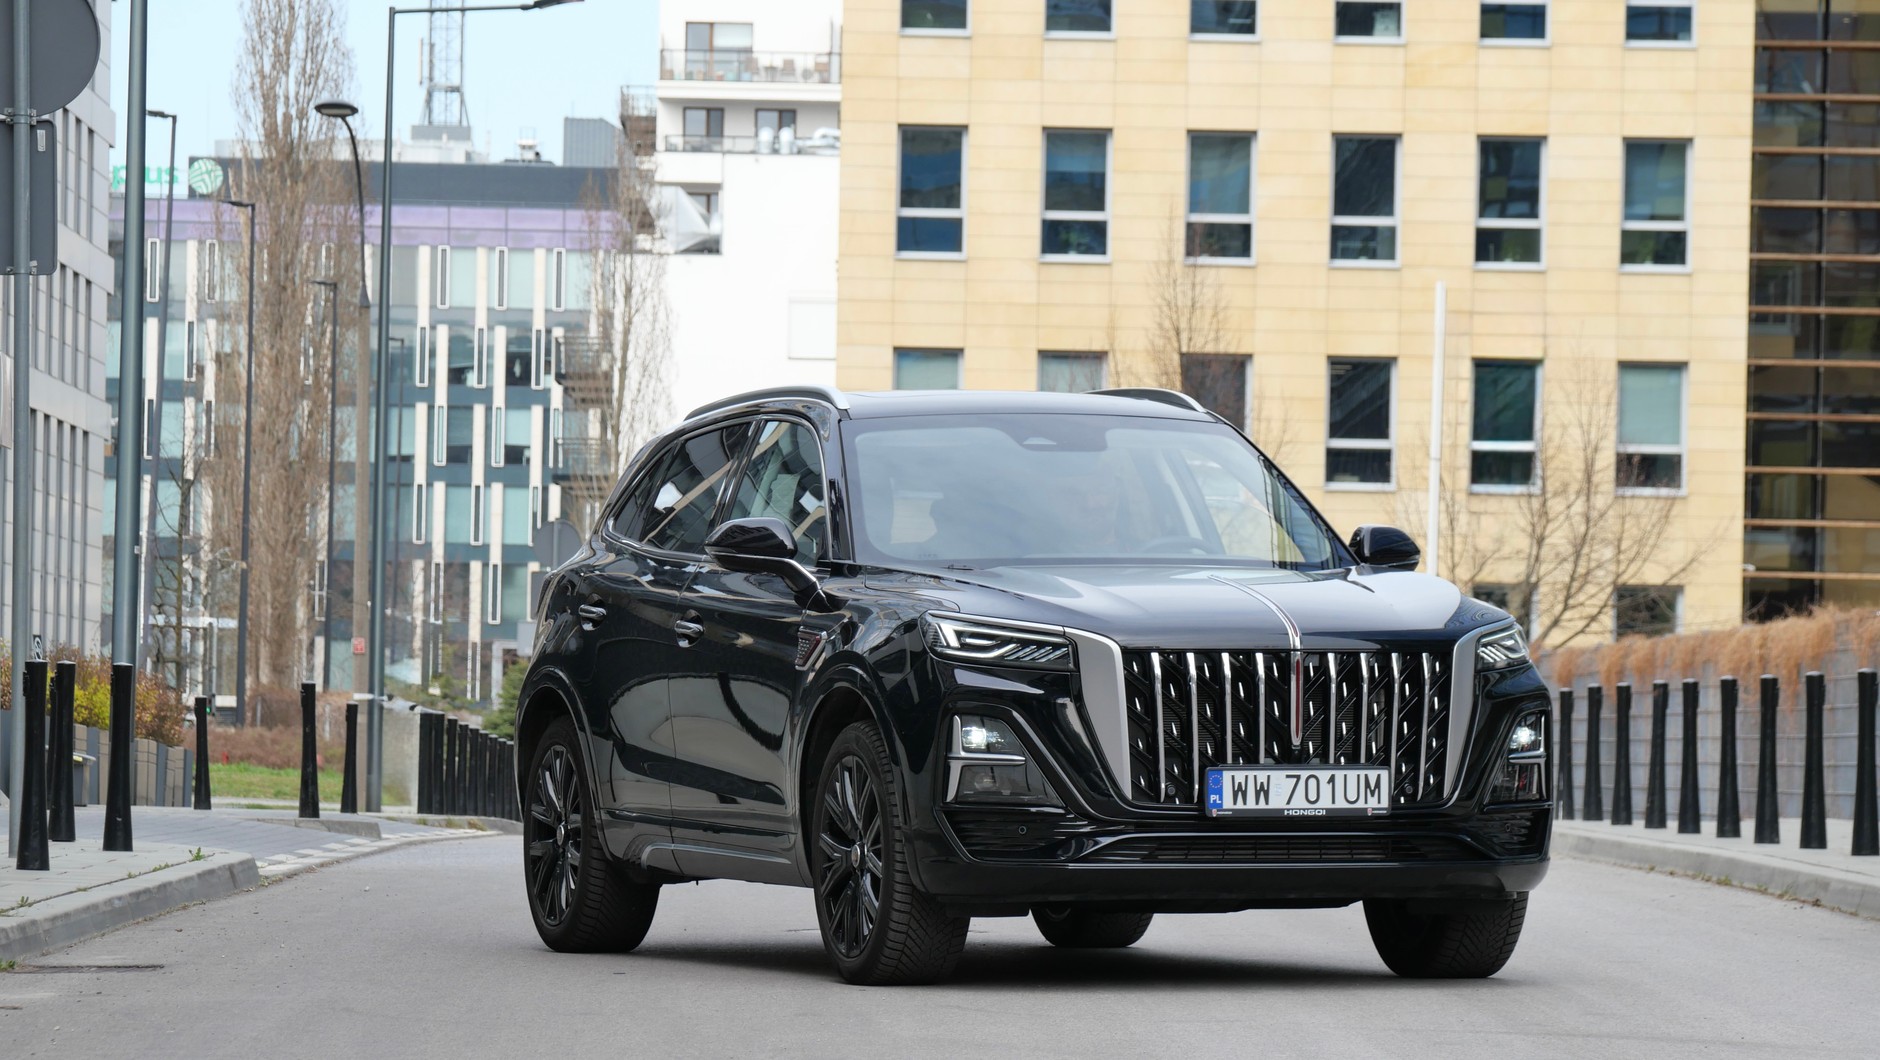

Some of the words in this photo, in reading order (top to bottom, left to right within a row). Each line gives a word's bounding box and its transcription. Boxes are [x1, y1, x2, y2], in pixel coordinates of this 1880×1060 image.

[111, 165, 180, 191] pus
[1210, 794, 1222, 804] PL
[1231, 774, 1271, 806] WW
[1285, 773, 1382, 806] 701UM
